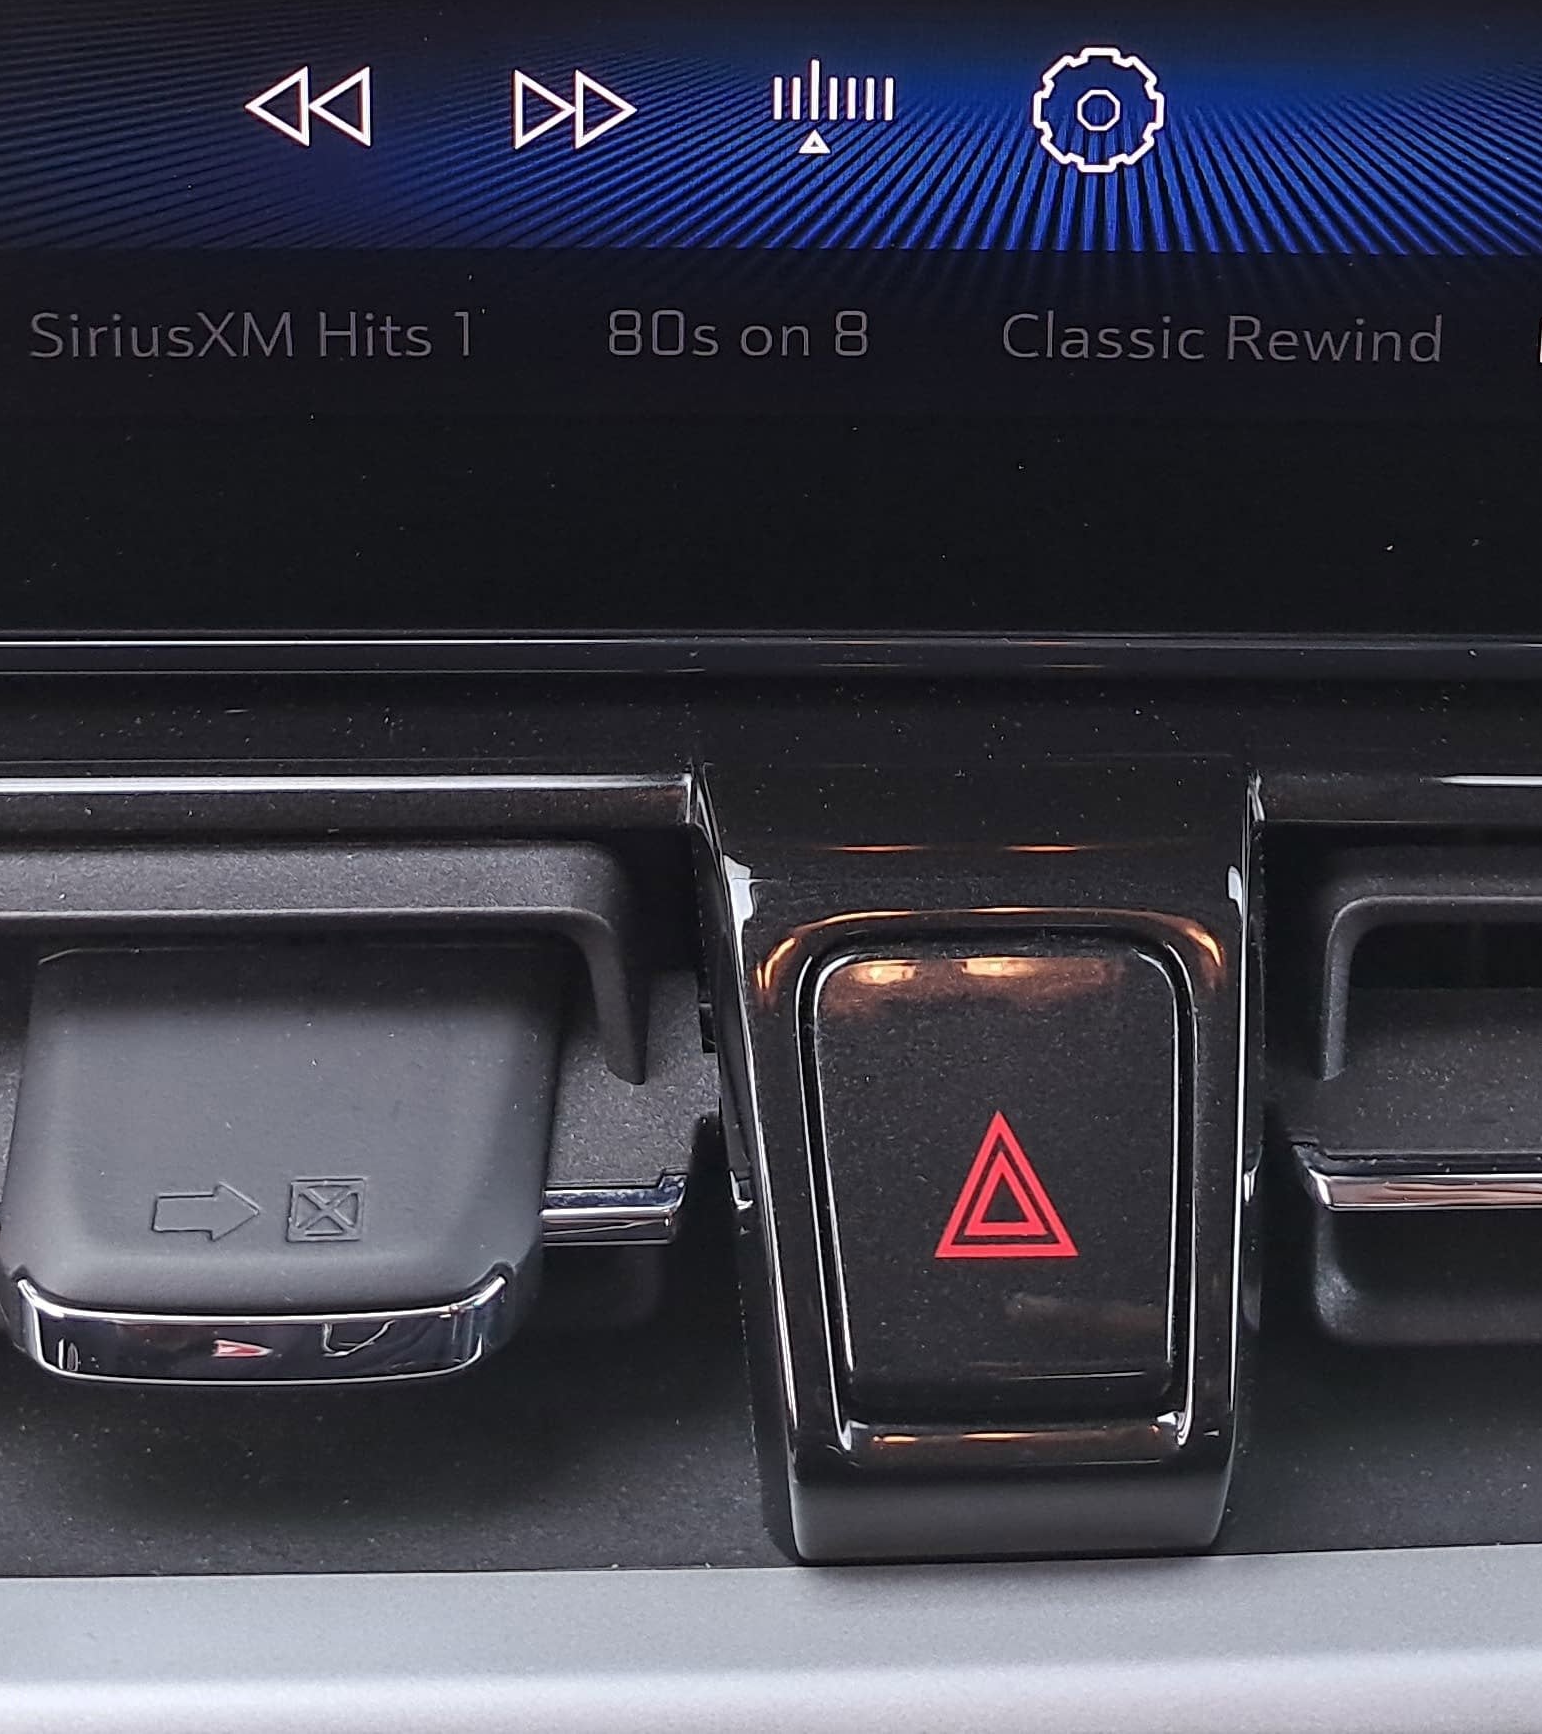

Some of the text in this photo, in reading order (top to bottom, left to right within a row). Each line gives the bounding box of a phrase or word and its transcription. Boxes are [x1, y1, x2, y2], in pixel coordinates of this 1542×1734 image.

[30, 310, 472, 359] SiriusXM Hits 1
[608, 309, 869, 357] 80s on 8
[1002, 309, 1443, 363] Classic Rewind
